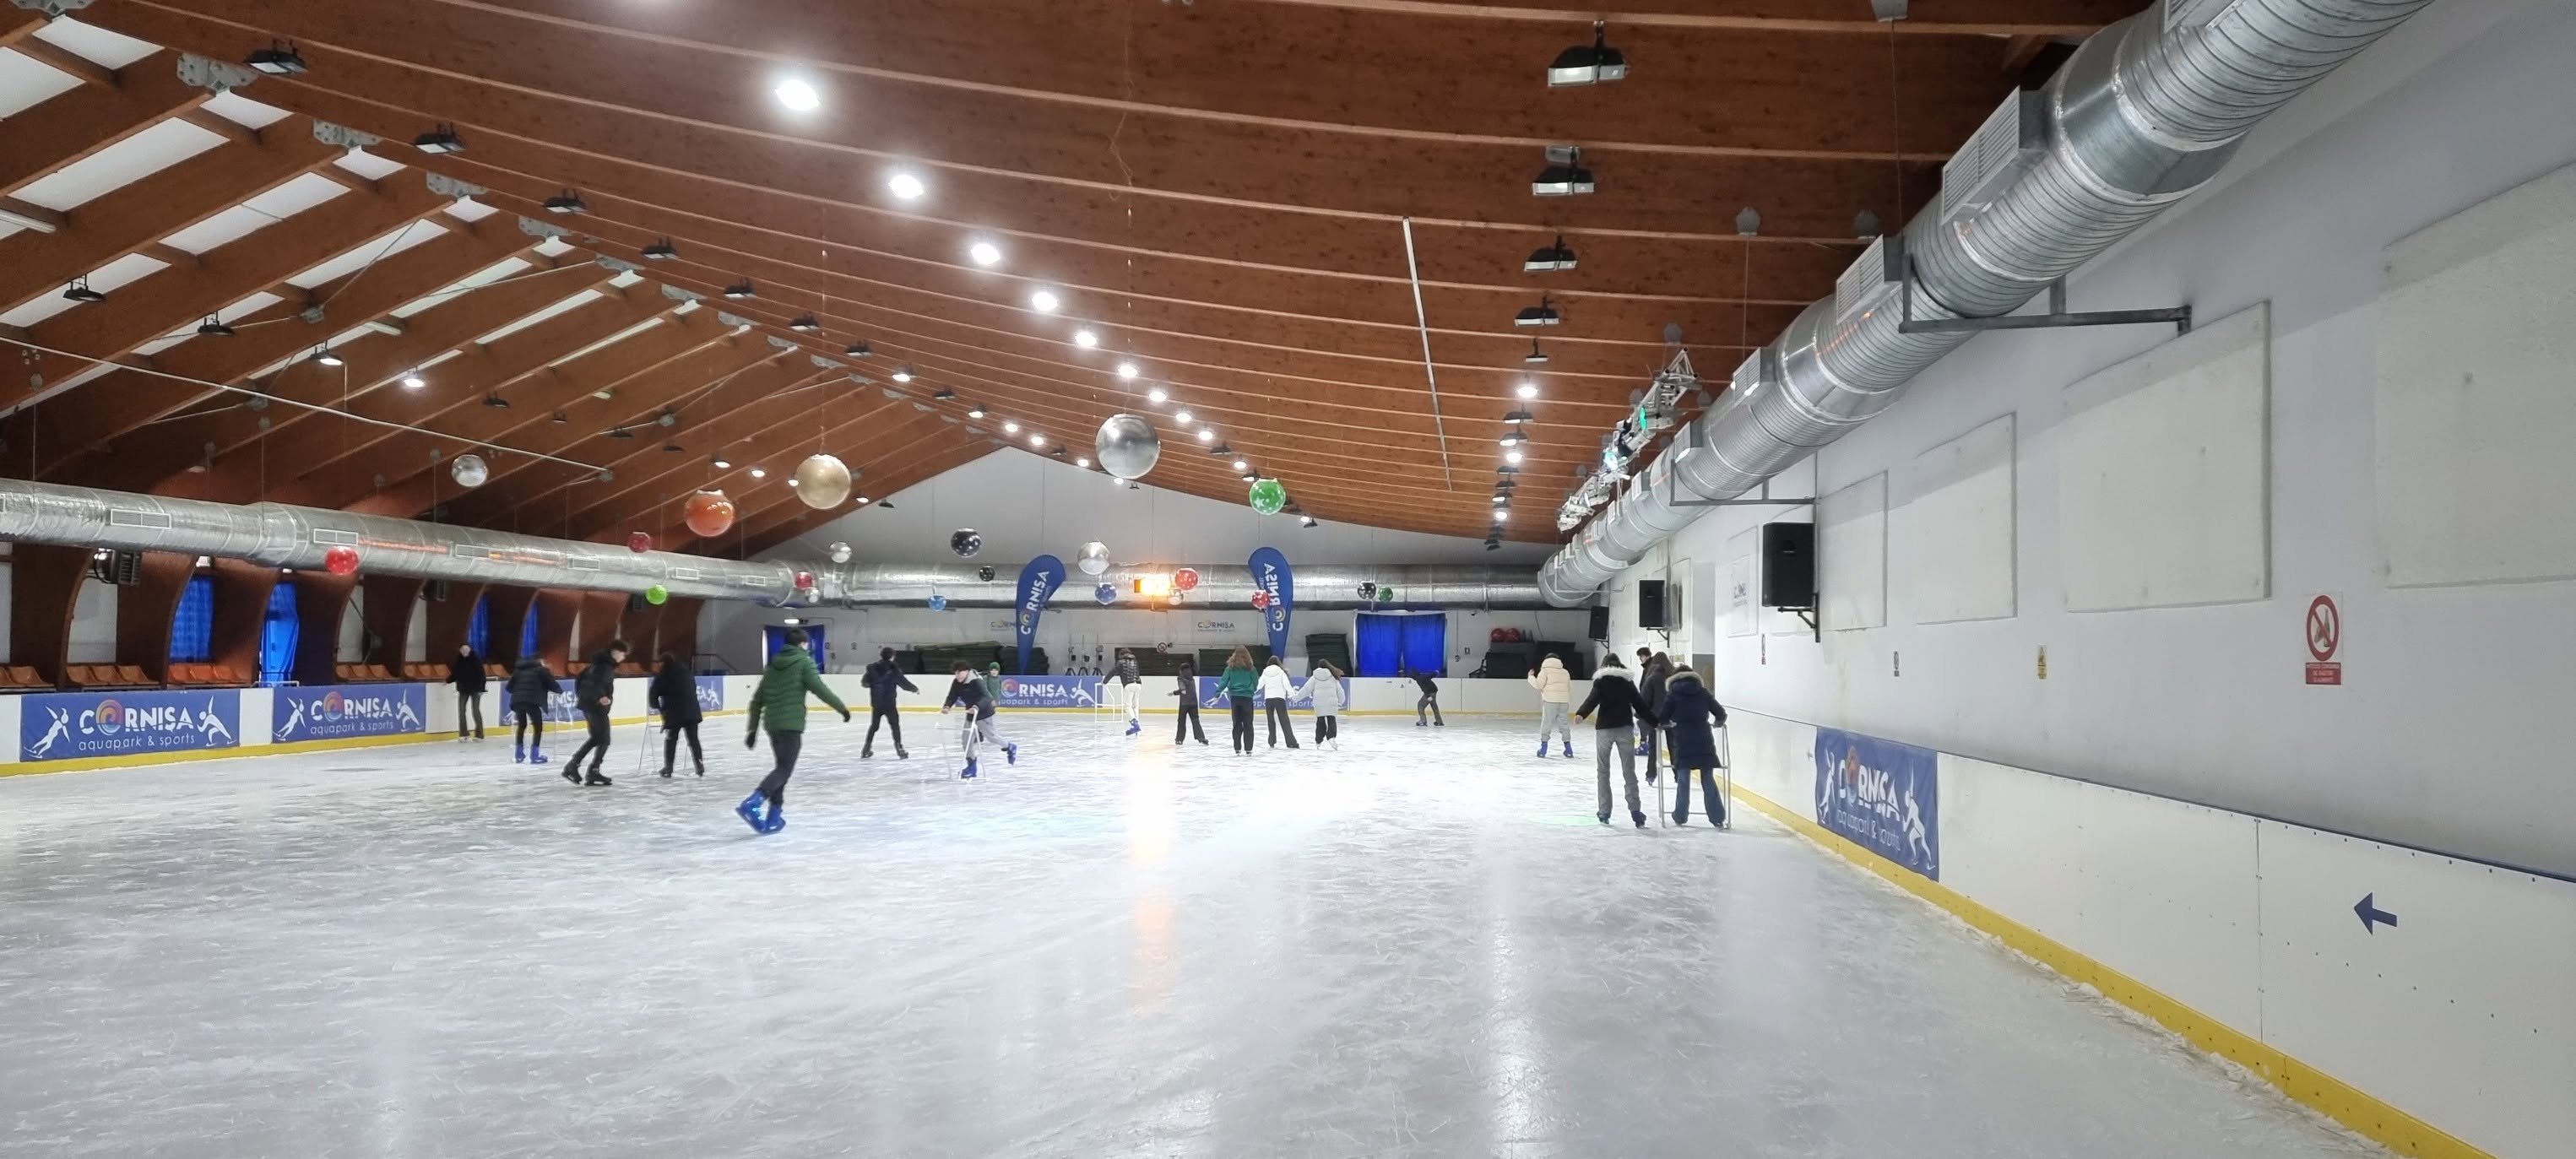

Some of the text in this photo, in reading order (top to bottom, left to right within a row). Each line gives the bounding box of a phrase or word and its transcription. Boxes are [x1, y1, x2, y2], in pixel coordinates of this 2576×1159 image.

[1021, 571, 1049, 635] CORNISA
[311, 720, 393, 736] aquapark & sports
[79, 733, 195, 751] aquapark & sports
